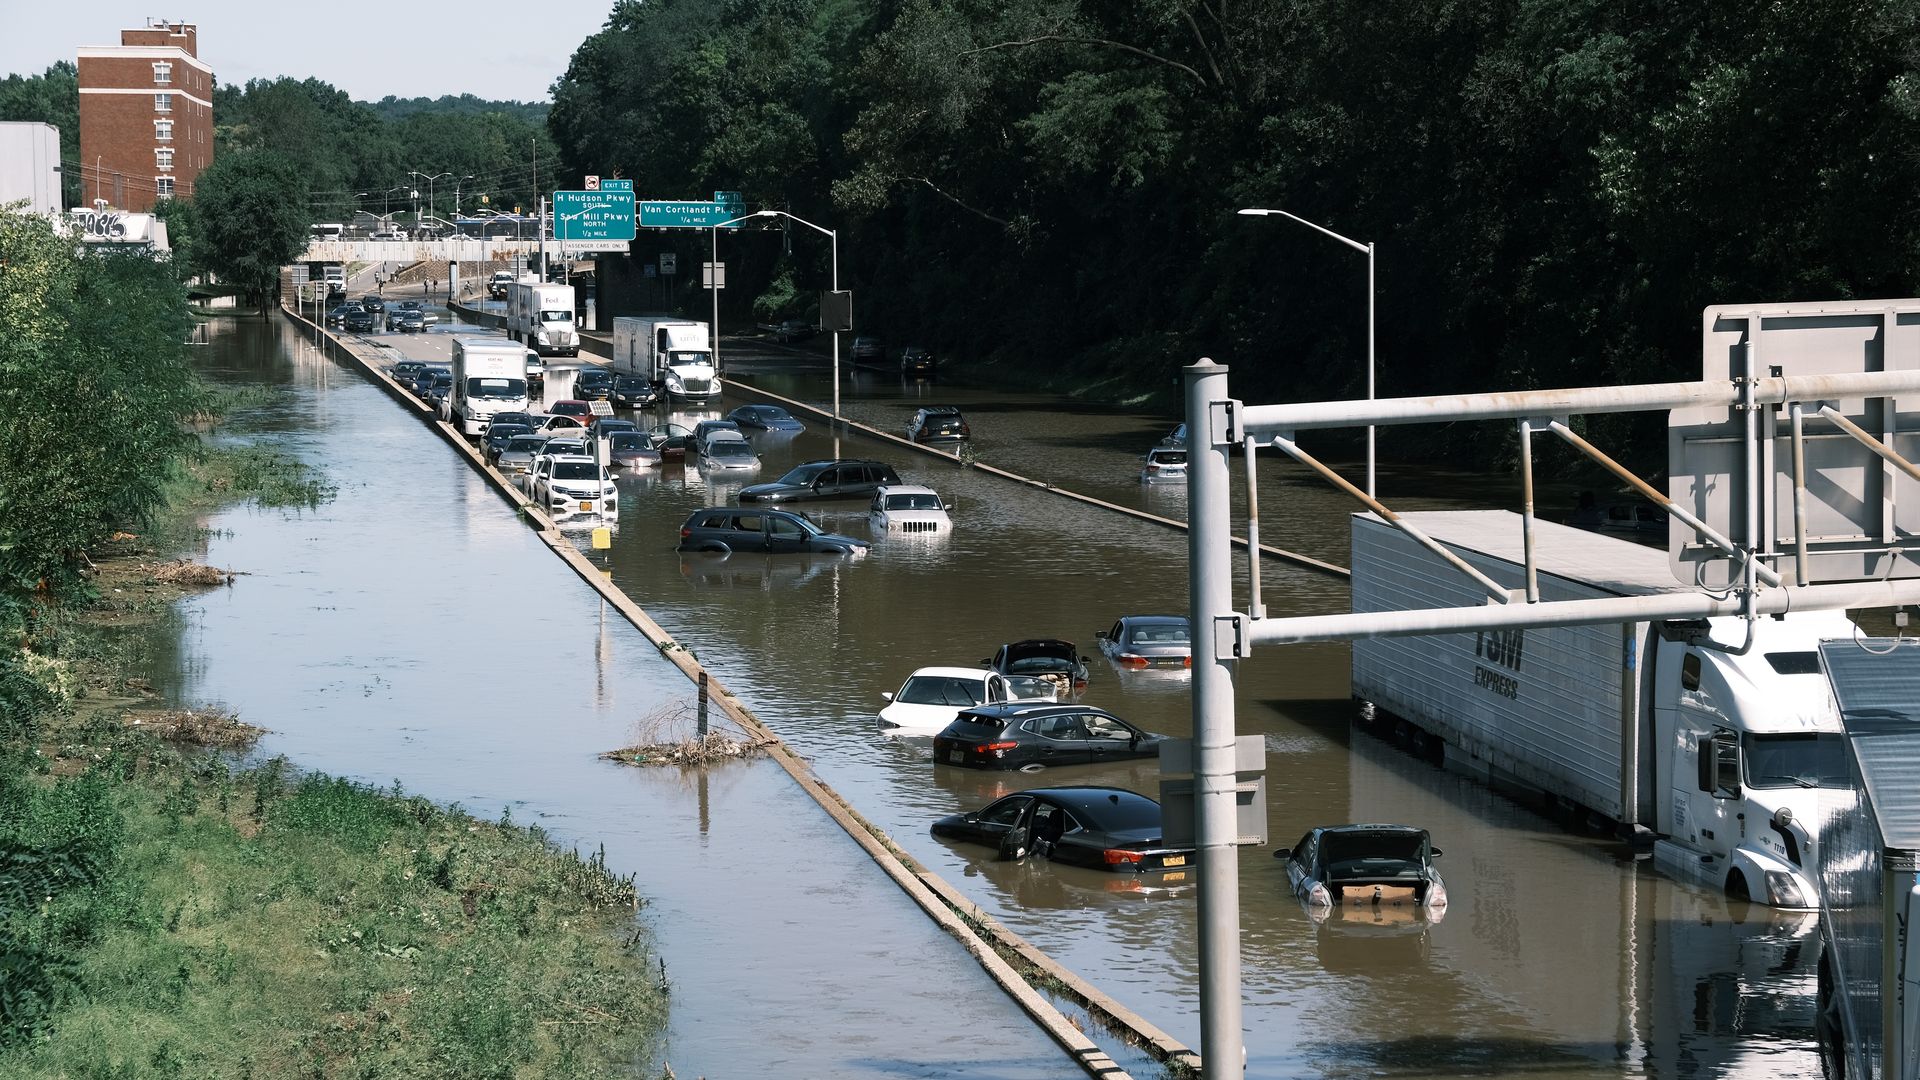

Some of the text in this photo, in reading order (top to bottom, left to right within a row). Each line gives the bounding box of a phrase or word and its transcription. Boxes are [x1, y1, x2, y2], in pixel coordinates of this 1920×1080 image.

[557, 194, 631, 203] H Hudson Pkwy
[666, 206, 710, 214] Cortlandt
[604, 213, 629, 222] Pkwy
[1474, 665, 1518, 700] EXPRESS
